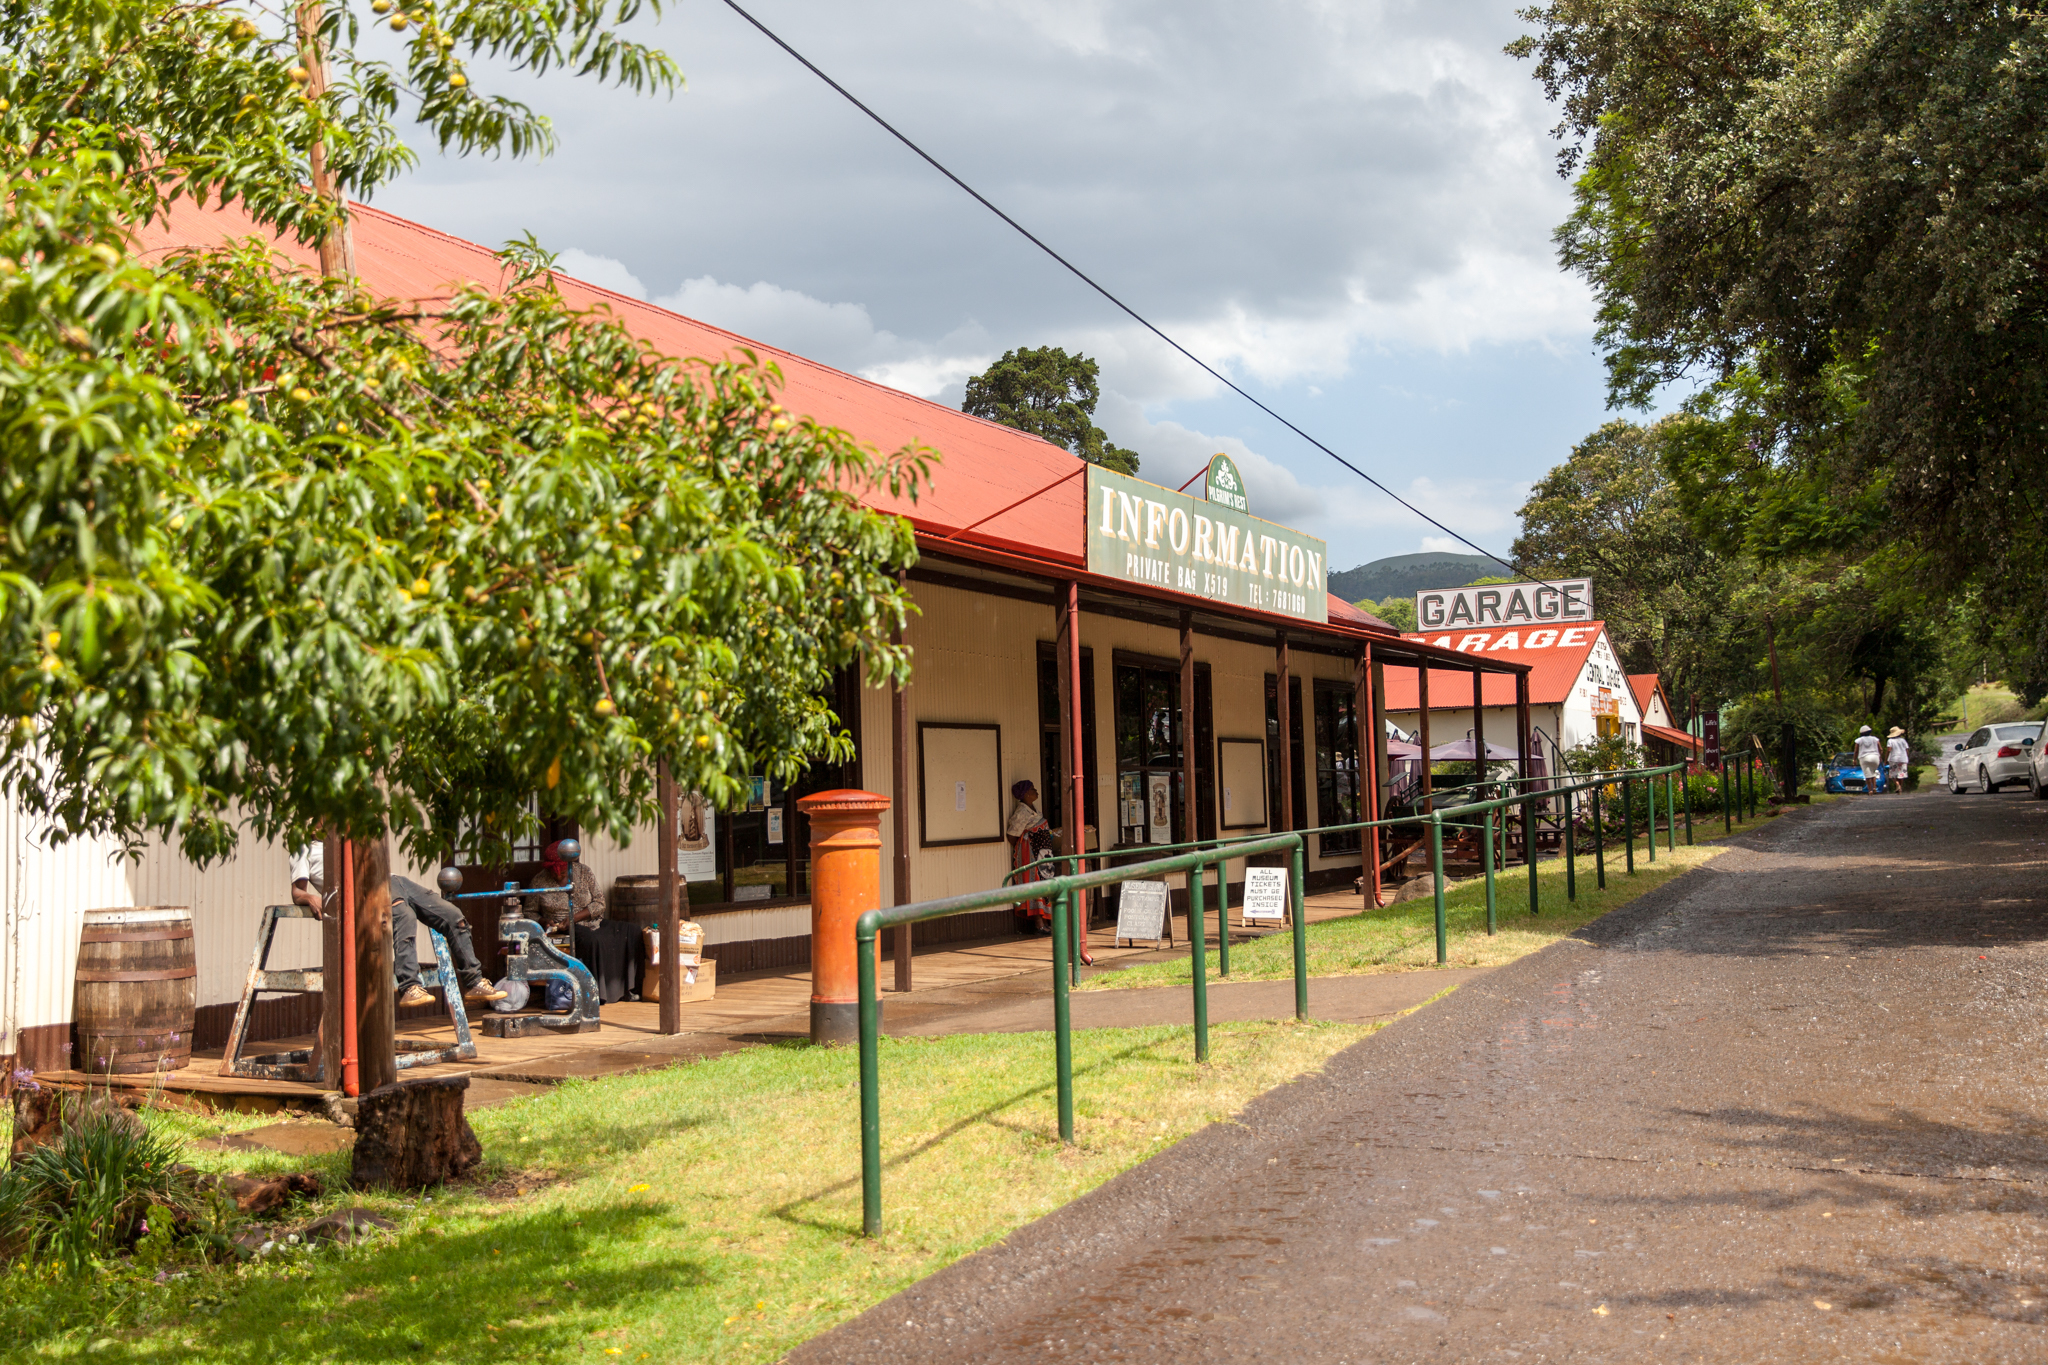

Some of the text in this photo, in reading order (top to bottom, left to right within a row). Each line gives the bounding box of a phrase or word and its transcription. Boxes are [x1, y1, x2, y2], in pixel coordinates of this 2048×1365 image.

[1234, 494, 1246, 511] REST
[1099, 485, 1322, 592] INFORMATION
[1126, 552, 1170, 584] PRIVATE
[1177, 565, 1196, 591] BAG
[1203, 572, 1228, 597] X519
[1272, 589, 1306, 614] 7681060
[1421, 584, 1586, 627] GARAGE
